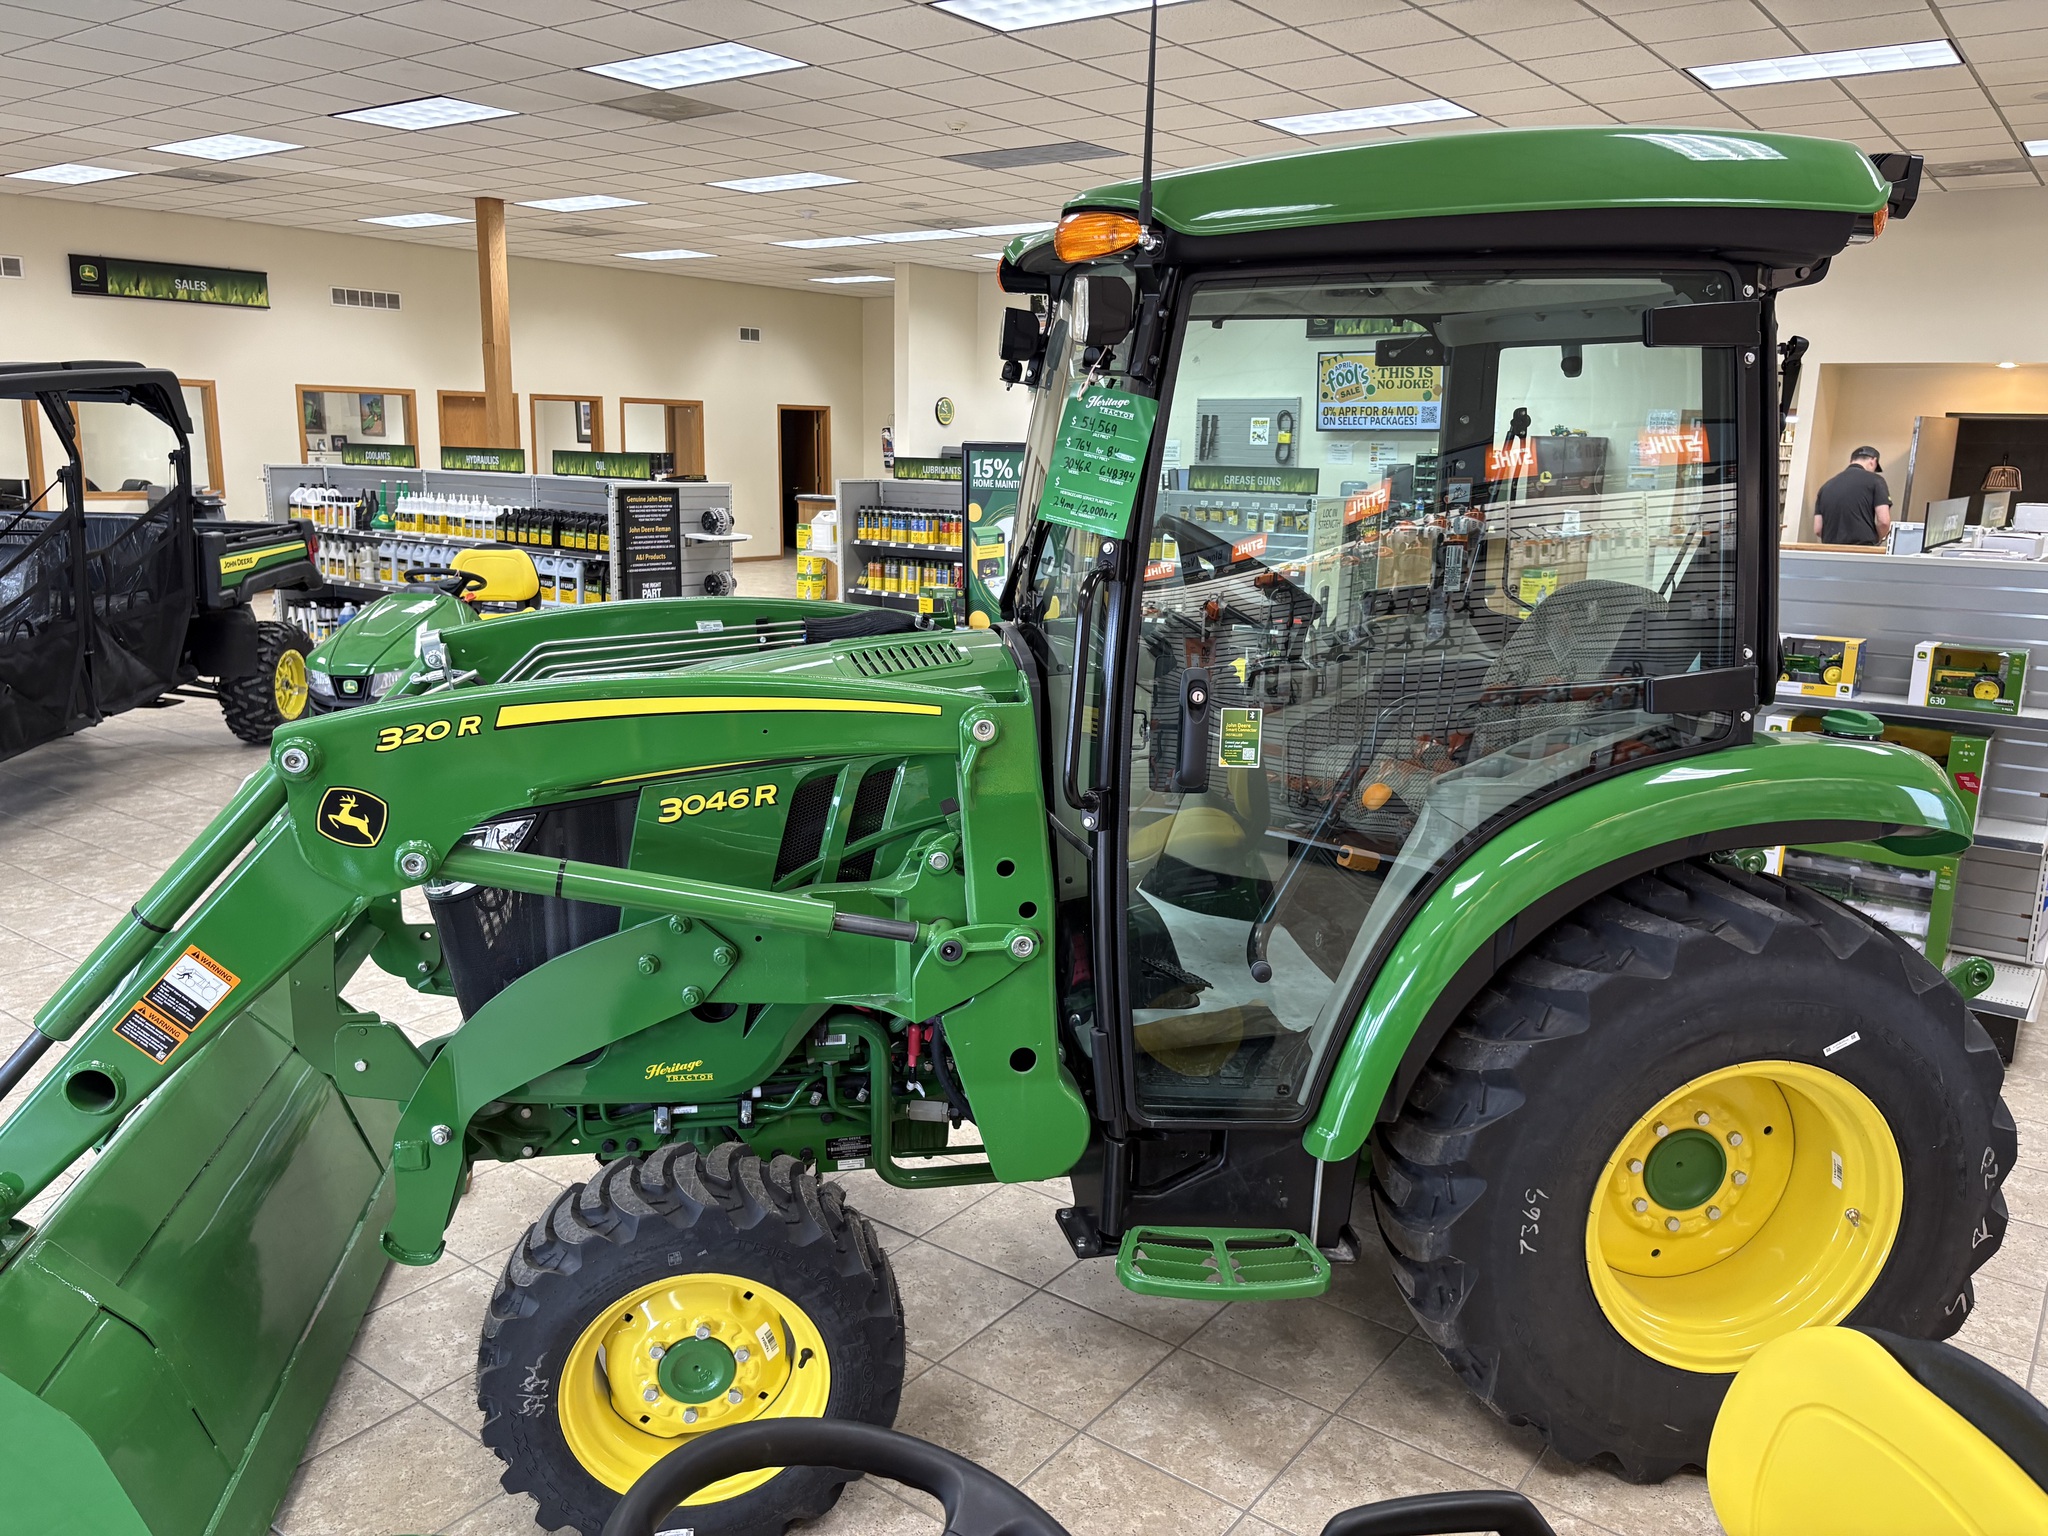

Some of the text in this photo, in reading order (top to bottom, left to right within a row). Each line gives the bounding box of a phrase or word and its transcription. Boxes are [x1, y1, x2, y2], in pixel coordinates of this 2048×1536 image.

[174, 278, 207, 292] SALES
[1334, 361, 1353, 372] APRIL
[1377, 366, 1434, 379] THIS IS
[1326, 363, 1370, 392] fool's
[1377, 379, 1433, 390] NO JOKE!
[1340, 386, 1361, 399] SALE
[1085, 395, 1131, 409] Heritage
[1099, 406, 1135, 420] TRACTOR
[1322, 406, 1418, 417] 0% APR FOR 84 MO.
[1080, 416, 1118, 437] 54,569
[1322, 416, 1418, 426] ON SELECT PACKAGES!
[1075, 437, 1092, 452] 764
[1095, 446, 1104, 455] for
[365, 451, 390, 461] COOLANTS
[466, 454, 499, 465] HYDRAULICS
[595, 460, 606, 471] OIL
[922, 465, 962, 475] LUBRICANTS
[972, 458, 1013, 479] 15%
[1063, 456, 1136, 483] 3046R 648394
[972, 479, 994, 488] HOME
[1224, 475, 1281, 486] GREASE GUNS
[224, 557, 253, 569] JOHN DEERE
[642, 588, 662, 599] PART
[1929, 697, 1946, 706] 630
[375, 715, 482, 753] 320 R
[658, 784, 778, 823] 3046 R
[200, 955, 233, 983] WARNING
[148, 1012, 181, 1038] WARNING
[645, 1059, 703, 1080] Heritage
[666, 1073, 714, 1082] TRACTOR
[1520, 1188, 1549, 1255] 7369
